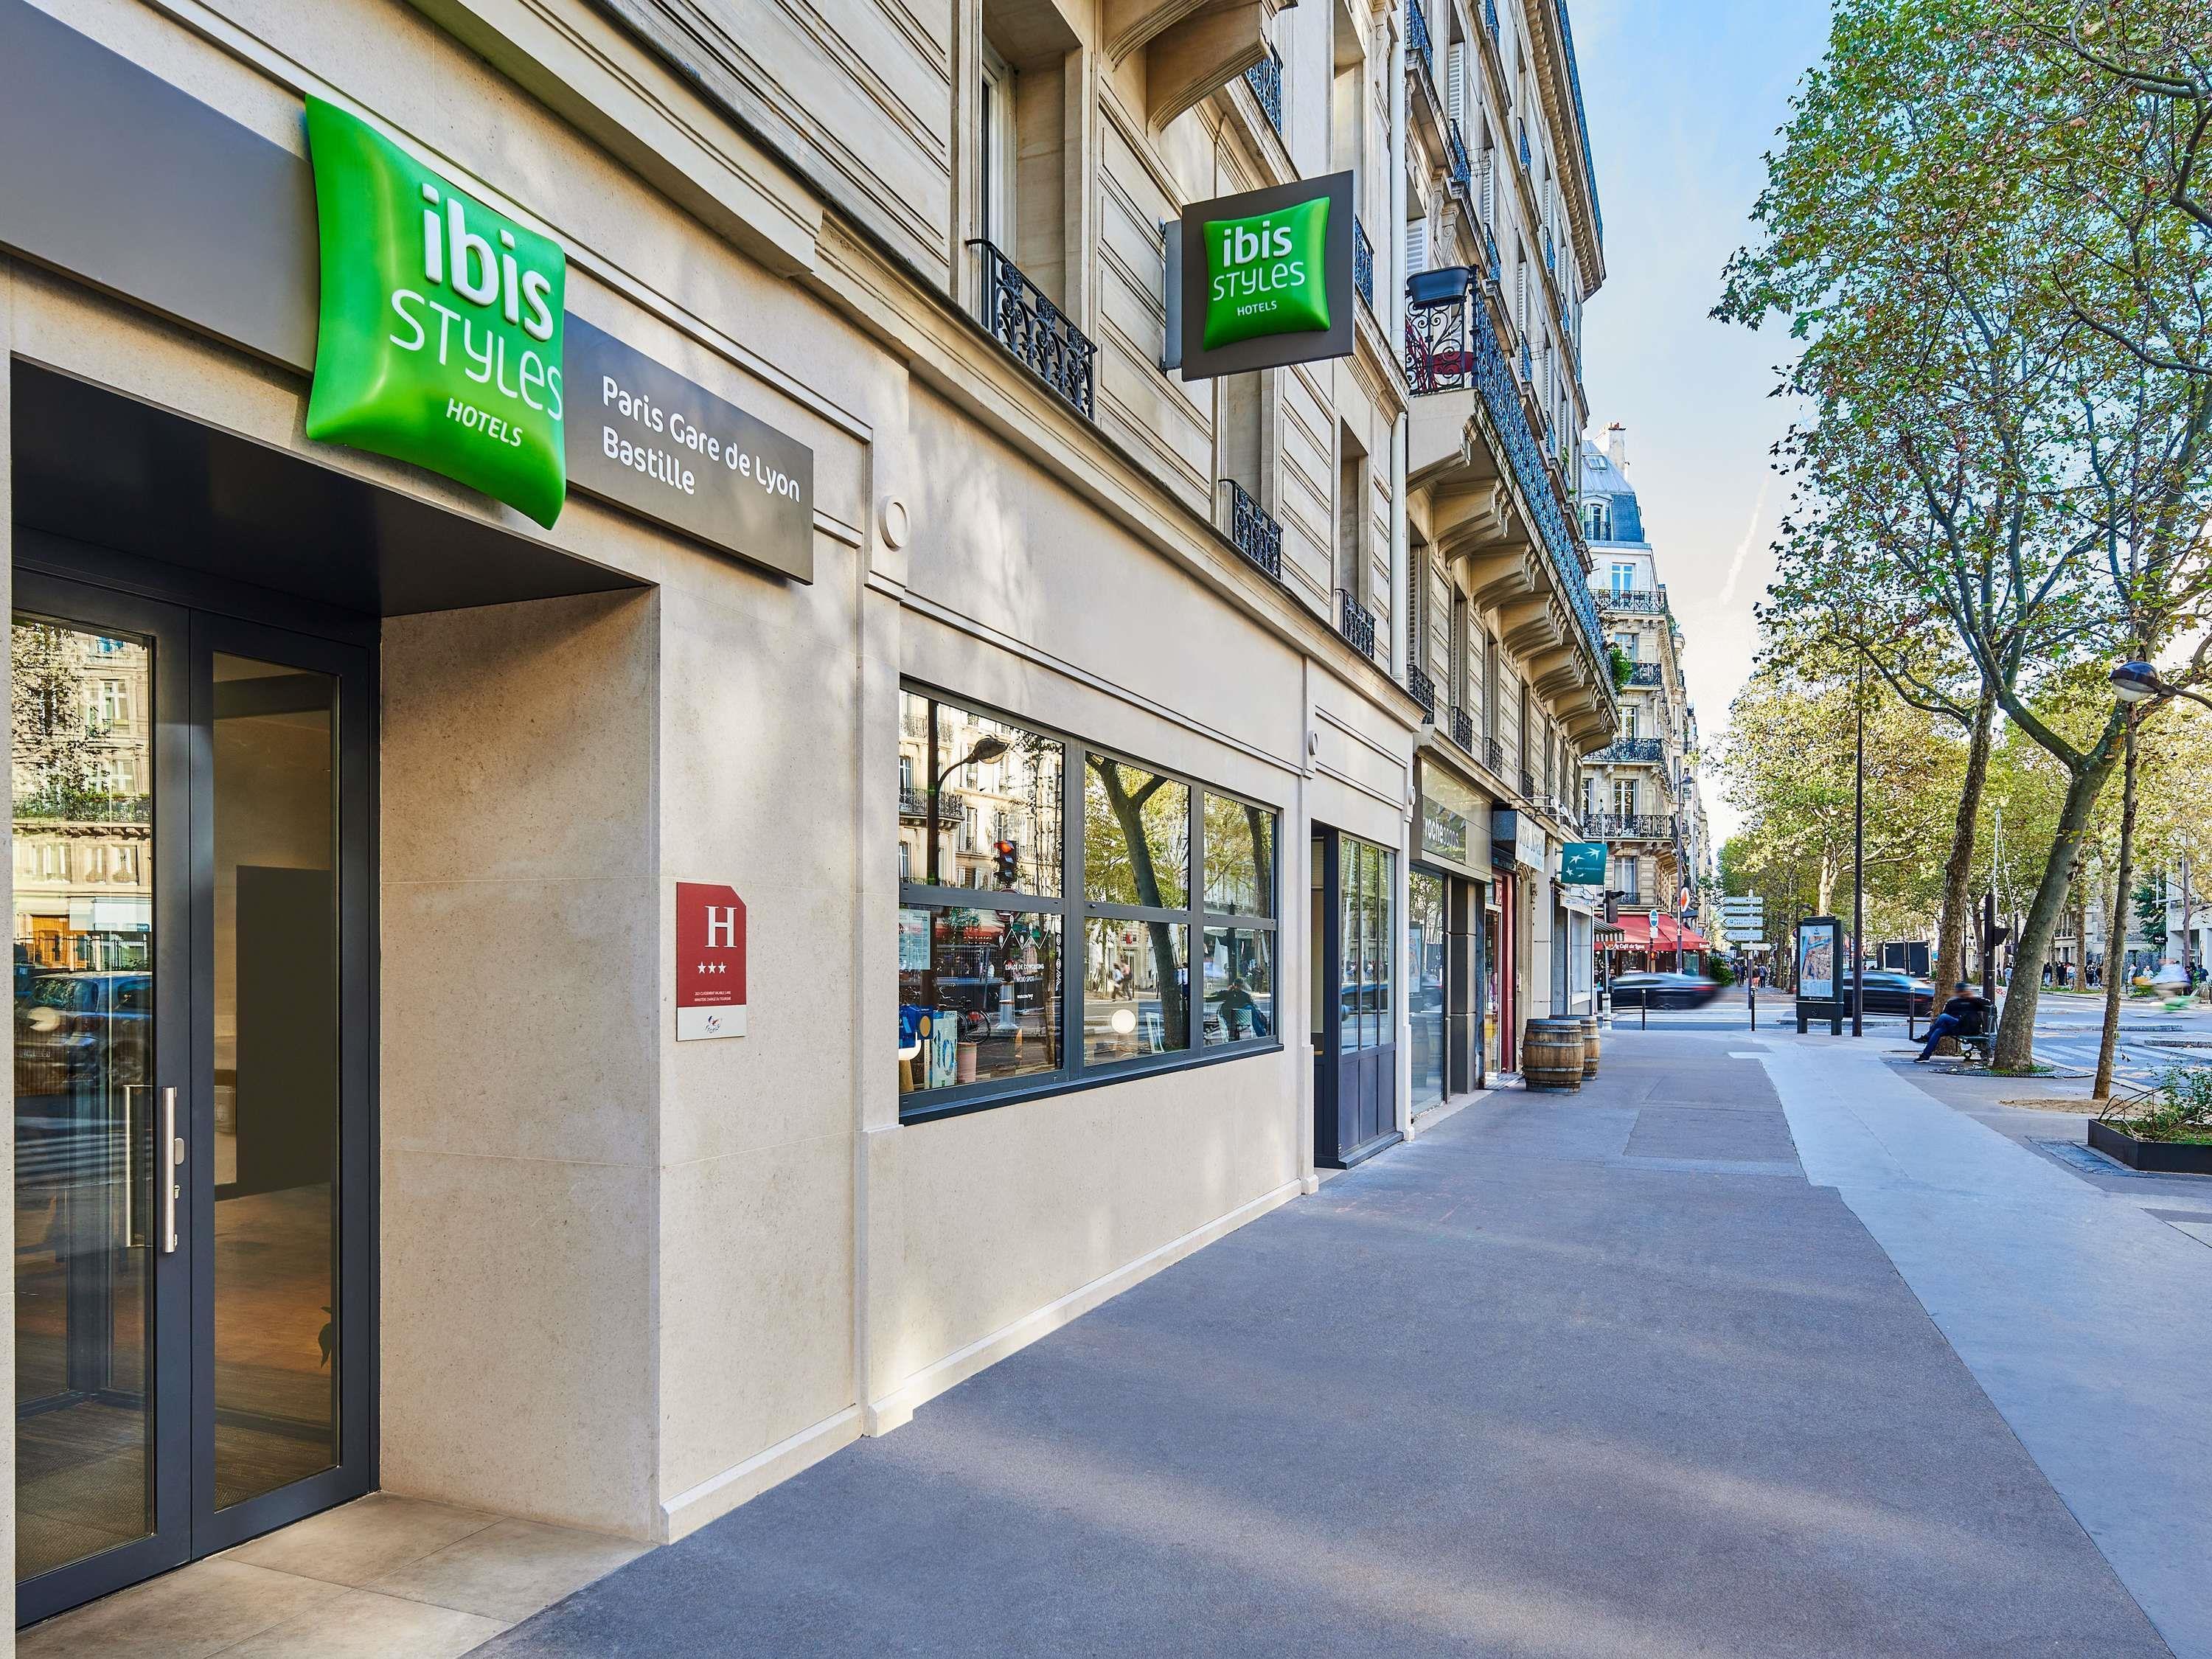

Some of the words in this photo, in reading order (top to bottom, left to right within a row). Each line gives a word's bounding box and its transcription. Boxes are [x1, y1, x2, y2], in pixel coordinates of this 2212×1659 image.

[422, 183, 554, 341] ibis
[1224, 220, 1293, 267] ibis
[1237, 300, 1277, 316] HOTELS
[446, 397, 523, 447] HOTELS
[602, 375, 663, 434] Paris
[669, 413, 720, 460] Gare
[725, 442, 751, 479] de
[756, 453, 801, 503] Lyon
[602, 426, 695, 495] Bastille
[705, 905, 737, 947] H
